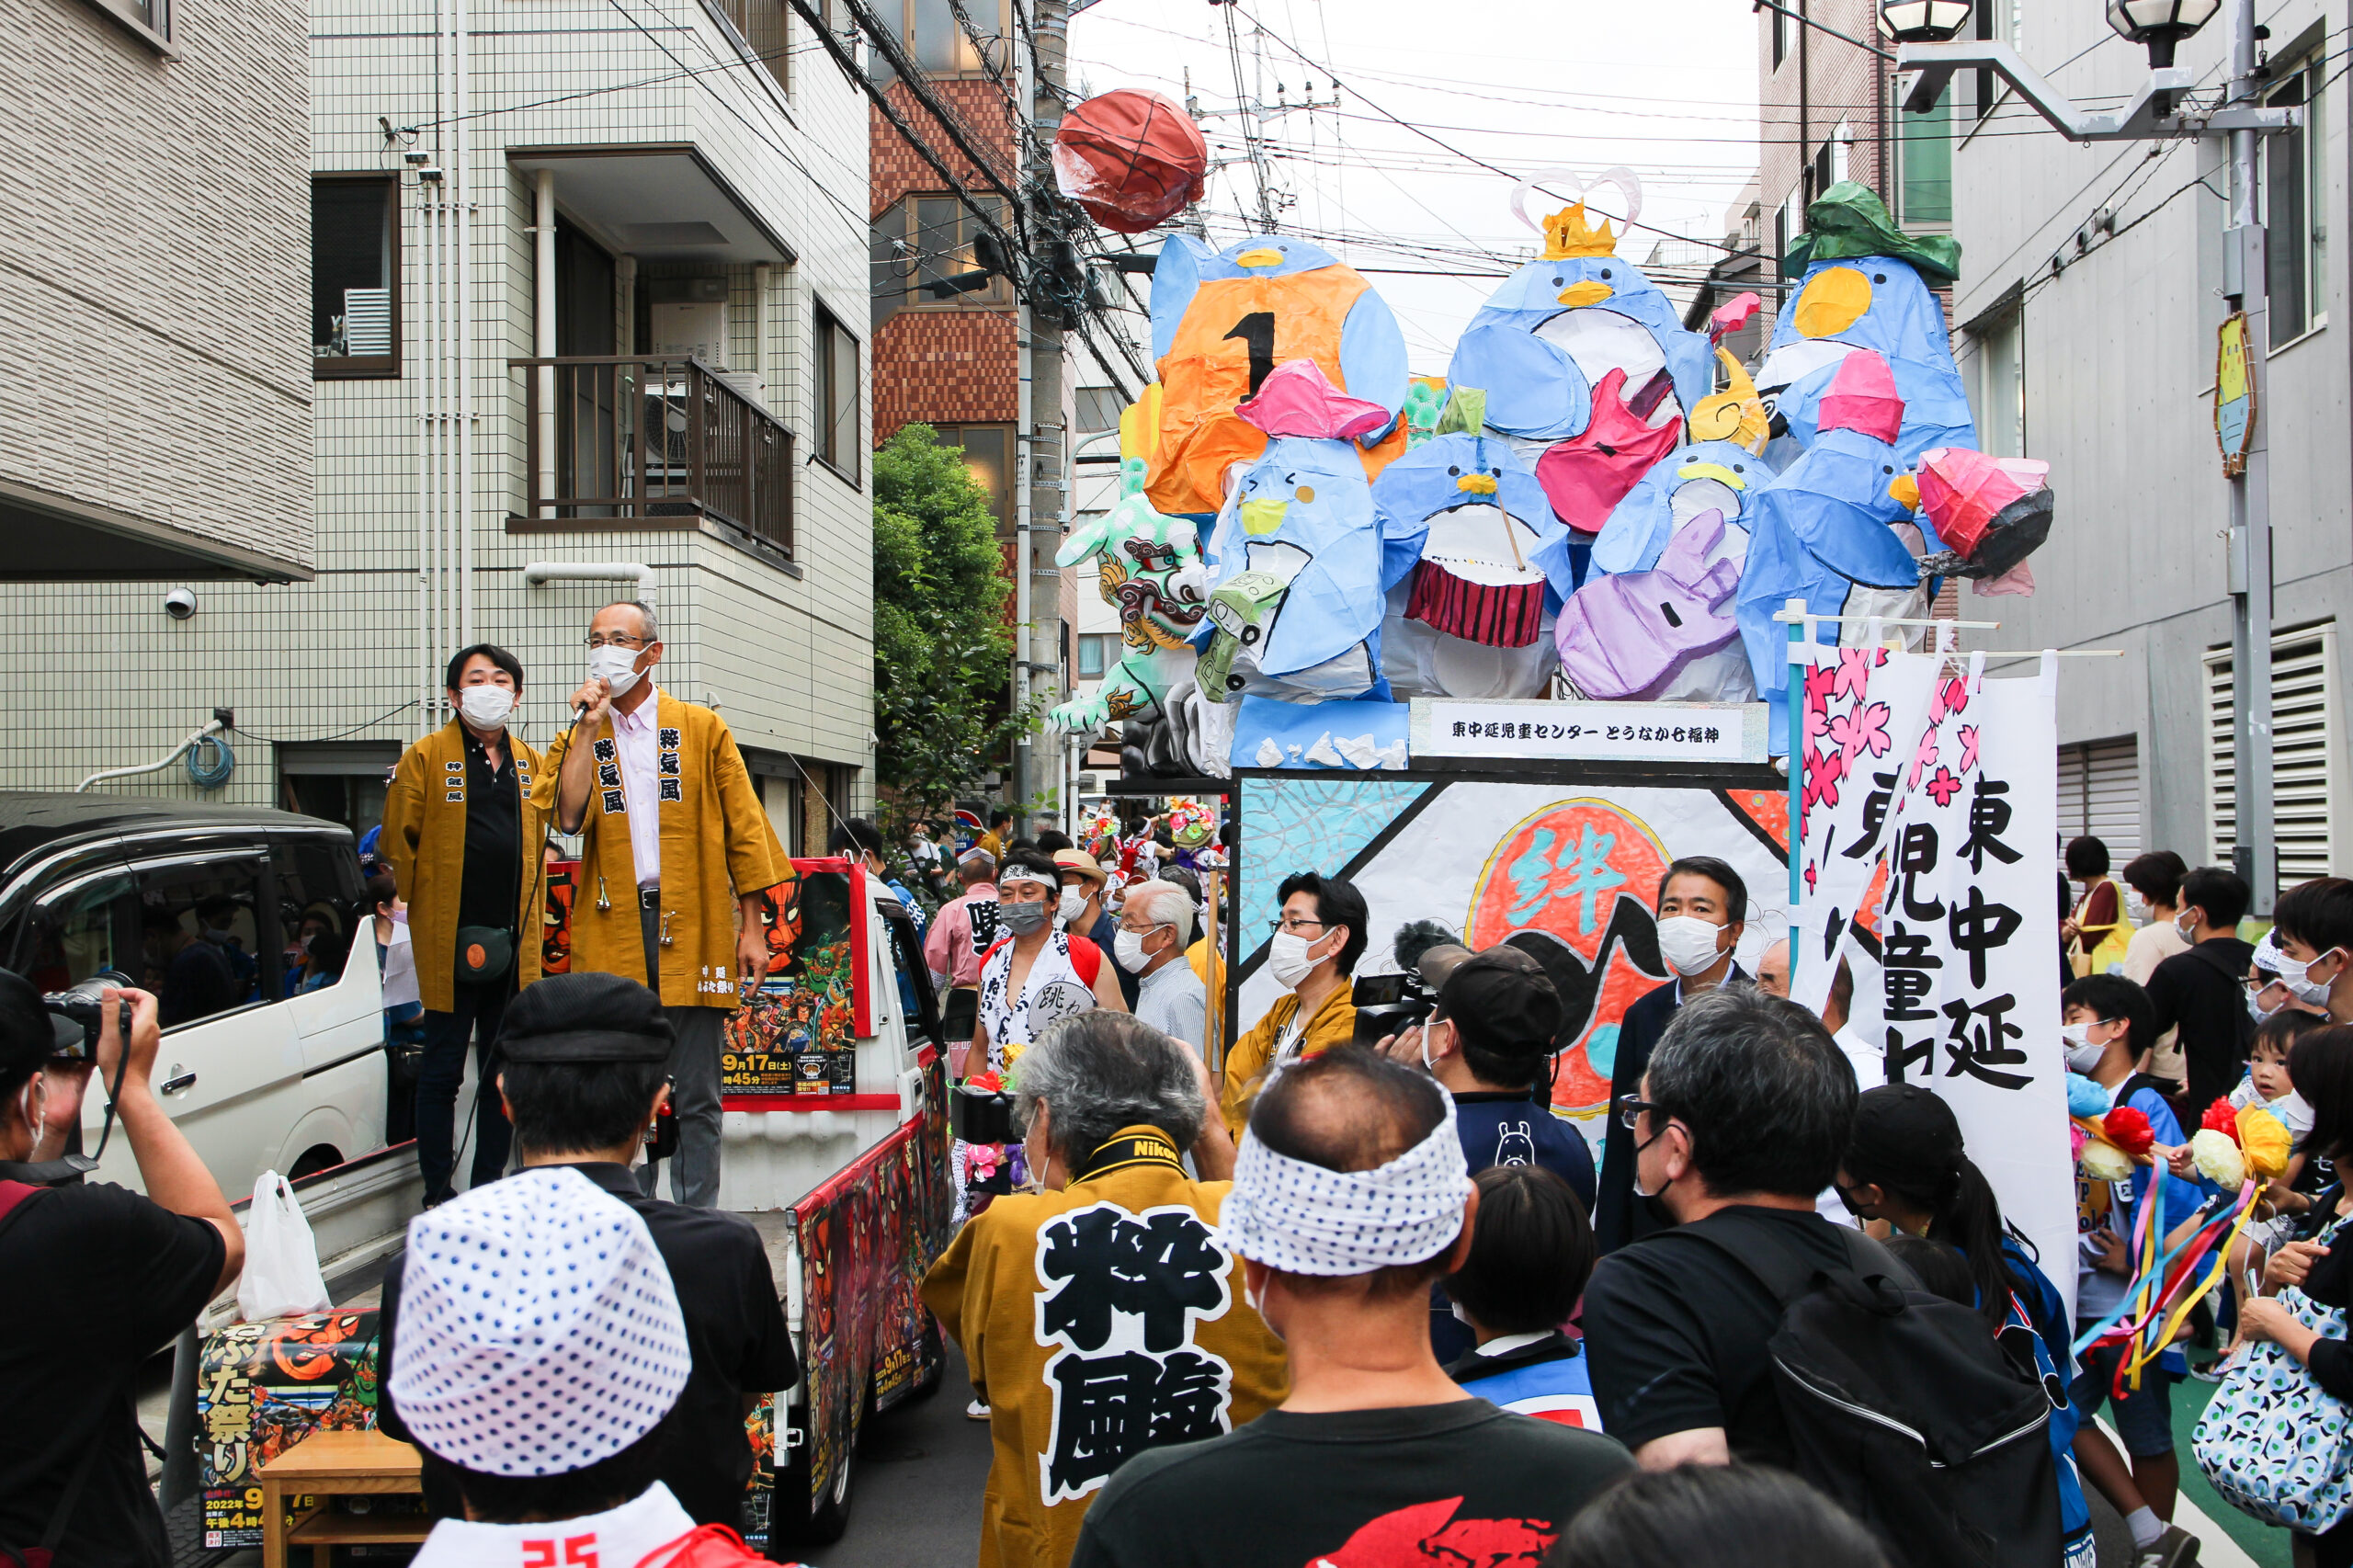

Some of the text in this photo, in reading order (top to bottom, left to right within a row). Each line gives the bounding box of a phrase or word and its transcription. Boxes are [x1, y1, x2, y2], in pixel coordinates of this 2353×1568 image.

[1223, 311, 1275, 403] 1
[1451, 720, 1720, 744] 東中延児童センター とうなか七福神
[1507, 823, 1627, 936] 絆
[1942, 771, 2035, 1090] 東中延
[722, 1054, 791, 1072] 9月17日(土)
[1134, 1141, 1179, 1164] Nikon
